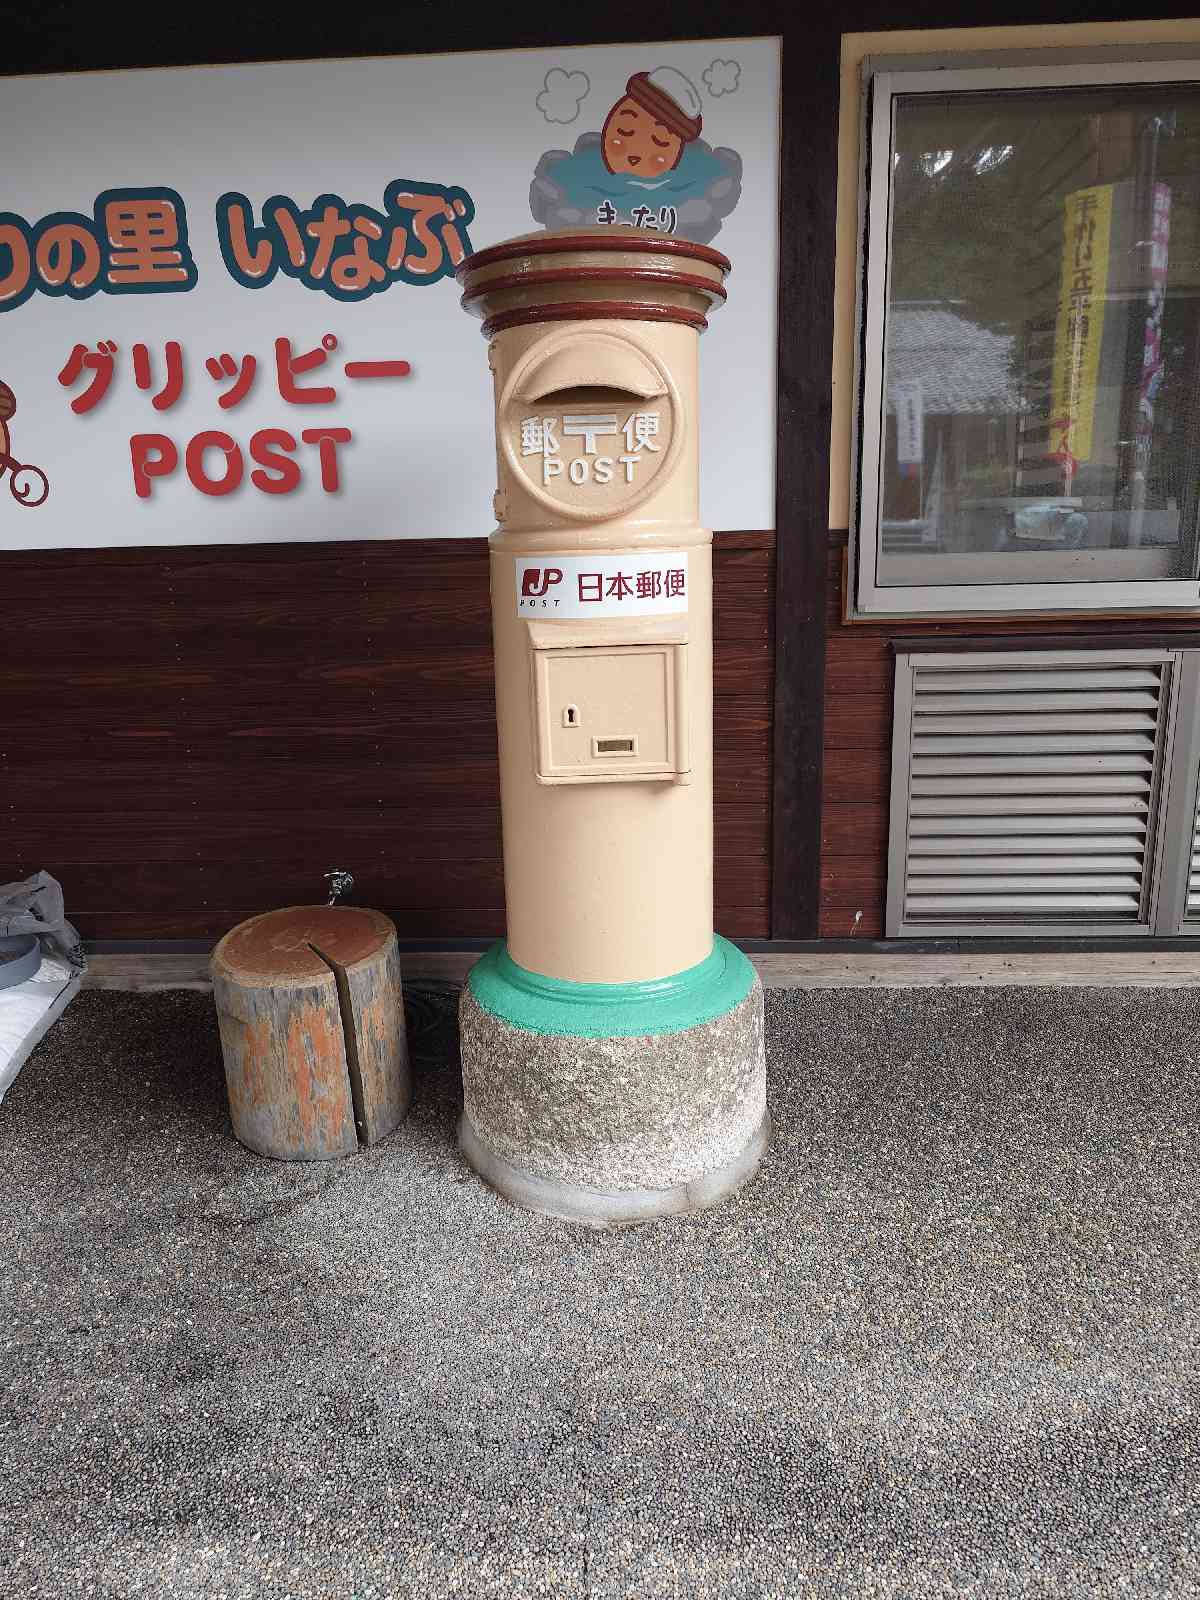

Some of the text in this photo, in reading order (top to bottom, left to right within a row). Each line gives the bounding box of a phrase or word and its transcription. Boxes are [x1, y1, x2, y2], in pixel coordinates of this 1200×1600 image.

[596, 199, 677, 234] またり
[226, 191, 467, 291] いなぶ
[57, 333, 411, 415] グリッピー
[129, 427, 353, 498] POST
[543, 455, 642, 487] POST
[577, 568, 686, 602] 日本郵便
[519, 599, 560, 608] POST
